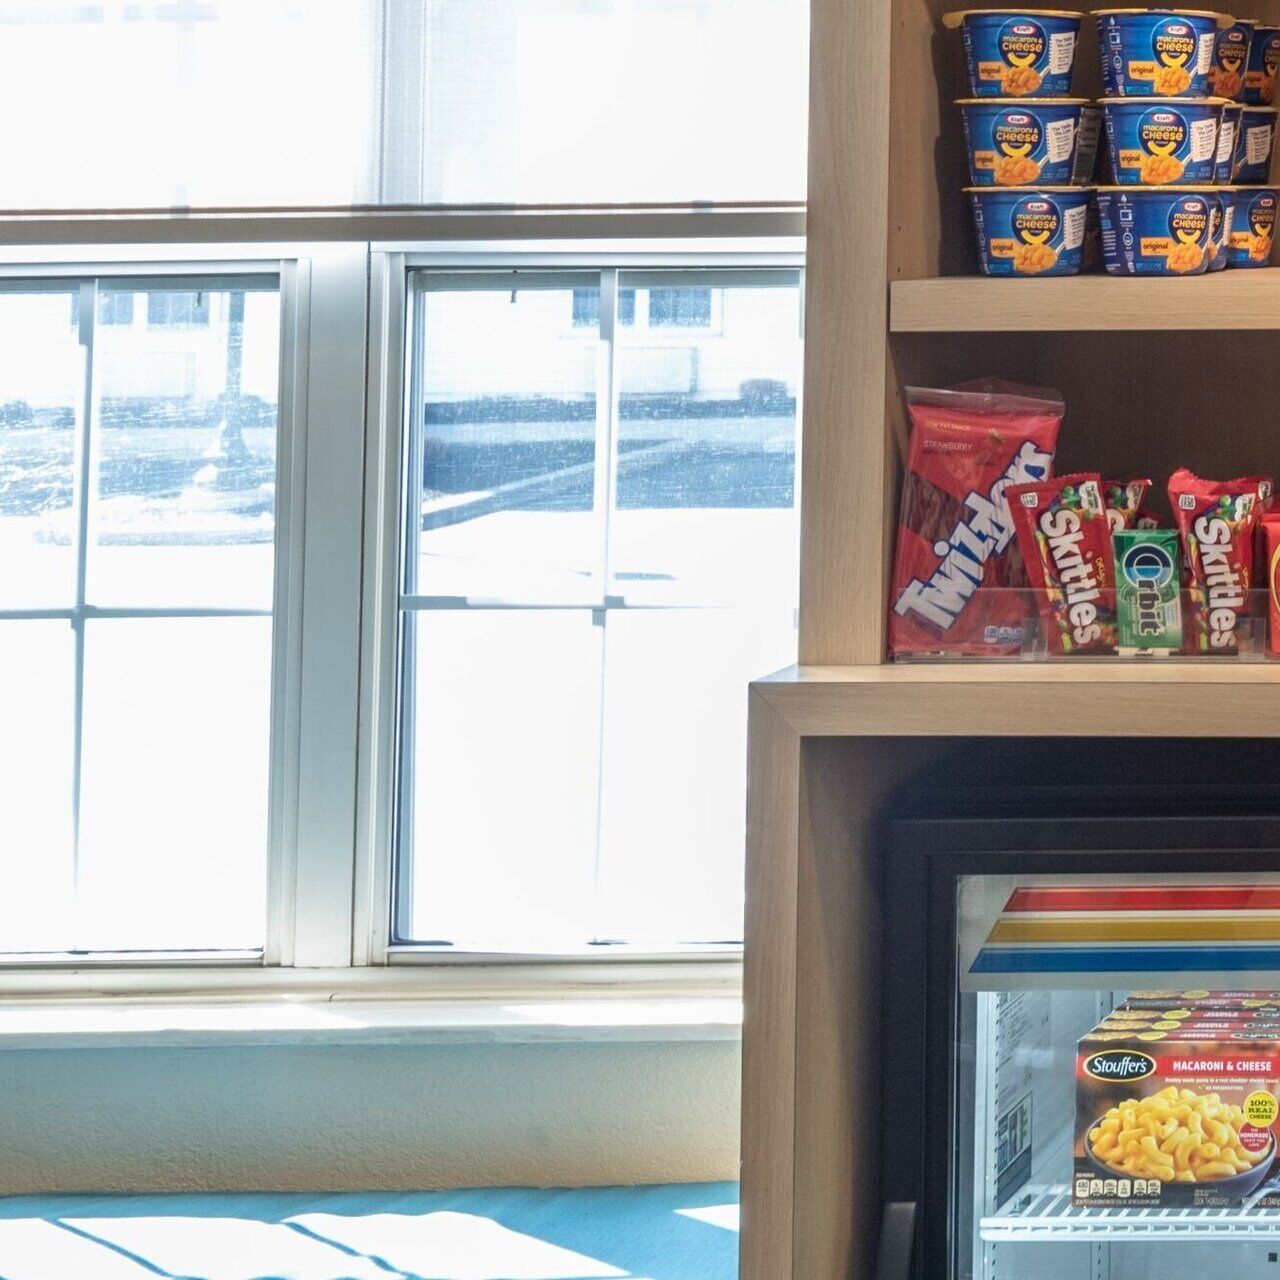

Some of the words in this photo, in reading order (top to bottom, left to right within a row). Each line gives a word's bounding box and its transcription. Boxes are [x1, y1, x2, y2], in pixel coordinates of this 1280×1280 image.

[924, 440, 974, 452] STRAWBERRY
[1039, 508, 1101, 646] Skittles
[1194, 515, 1244, 649] Skittles
[1092, 1057, 1147, 1075] Stouffer's
[1172, 1060, 1224, 1071] MACARONI
[1226, 1061, 1234, 1071] &
[1236, 1061, 1272, 1071] CHEESE
